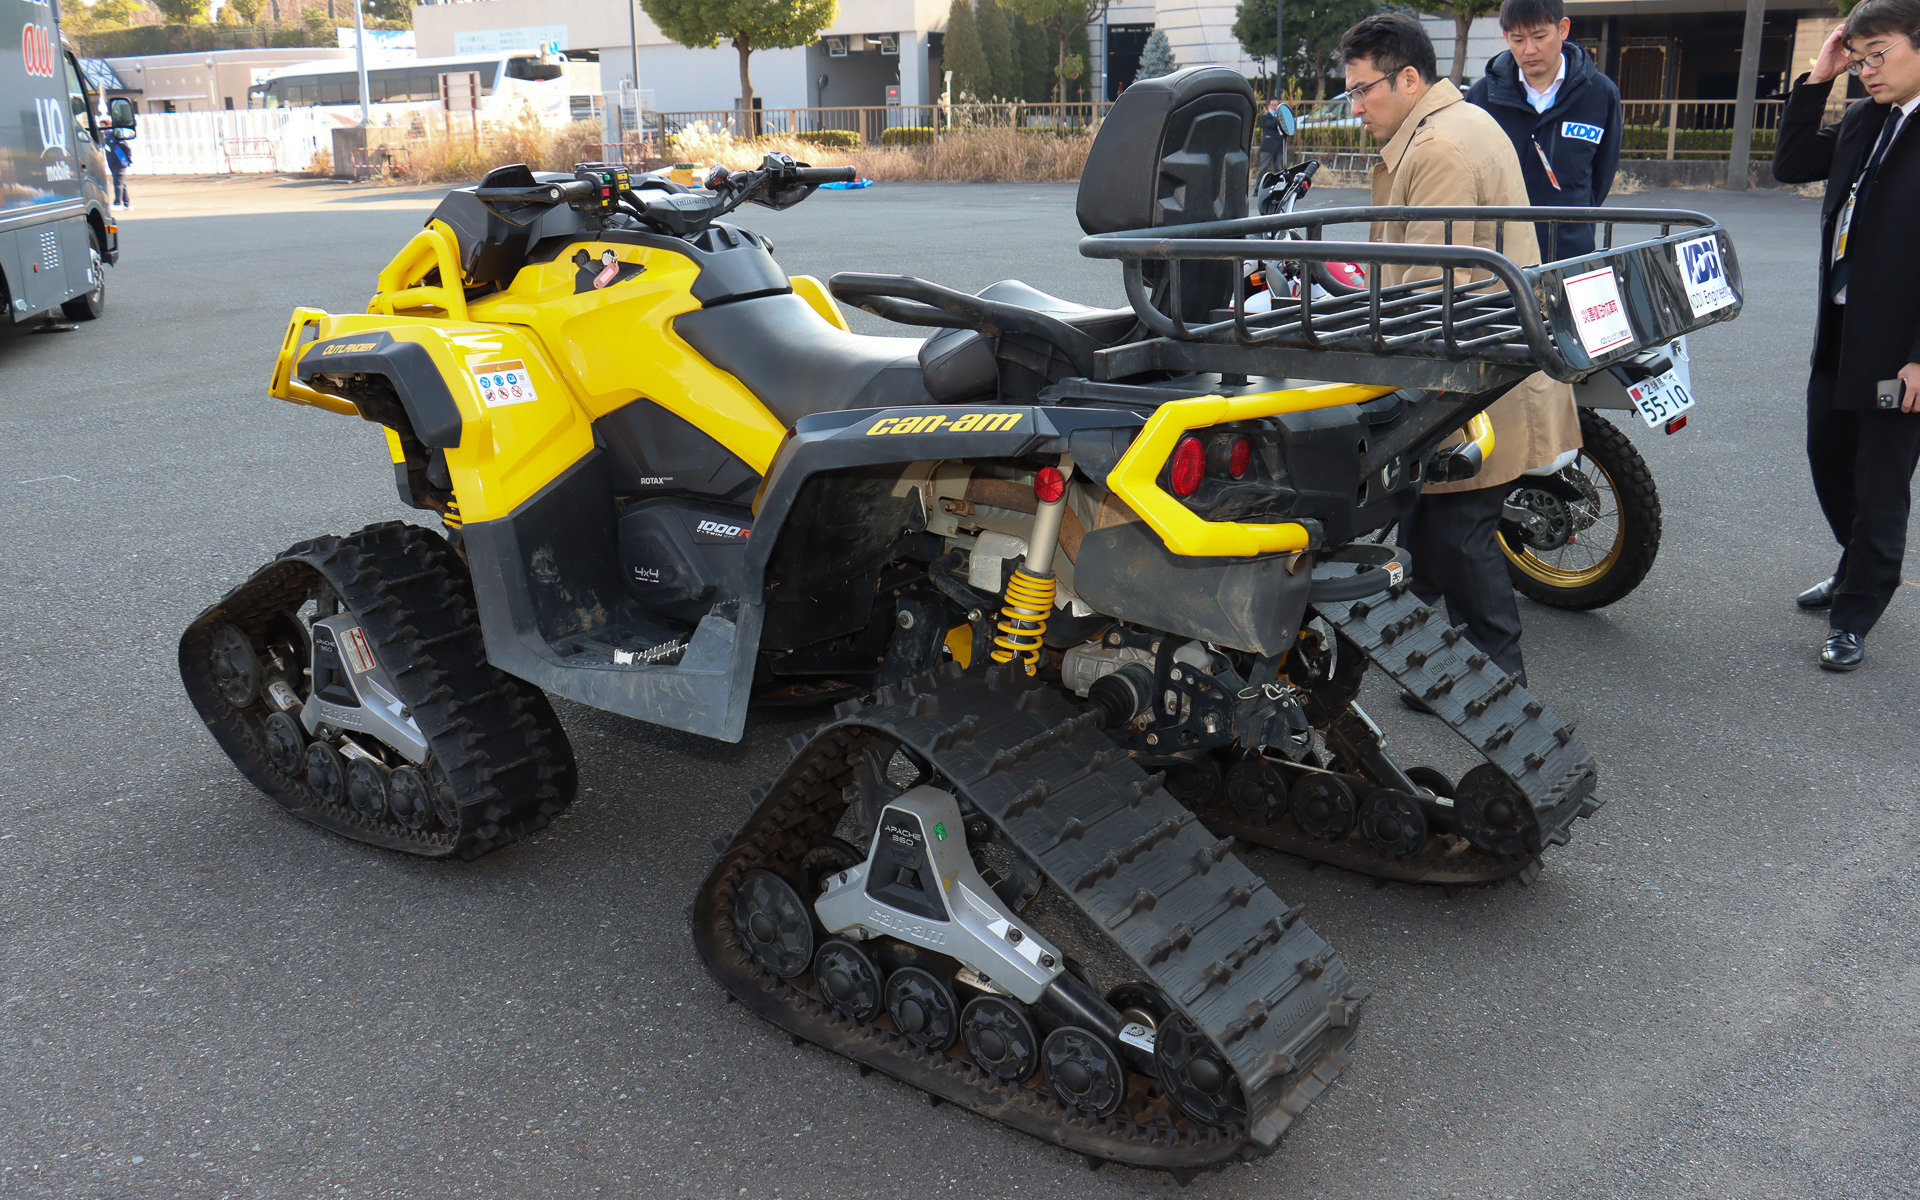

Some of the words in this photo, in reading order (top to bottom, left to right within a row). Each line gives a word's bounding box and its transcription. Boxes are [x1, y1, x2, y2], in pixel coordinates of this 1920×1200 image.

[22, 22, 55, 78] au
[36, 98, 68, 157] UQ
[1564, 123, 1601, 142] KDDI
[46, 161, 71, 182] mobile
[1683, 239, 1721, 285] KDDI
[321, 343, 377, 356] OUTLANDER
[1641, 384, 1689, 422] 55-10
[865, 413, 1024, 436] can-am
[640, 477, 664, 485] ROTAX
[697, 519, 751, 539] 1000R
[634, 566, 659, 578] 4x4
[884, 824, 922, 841] APACHE
[892, 834, 914, 847] 360
[868, 907, 948, 946] can-am
[1272, 992, 1317, 1039] can-am
